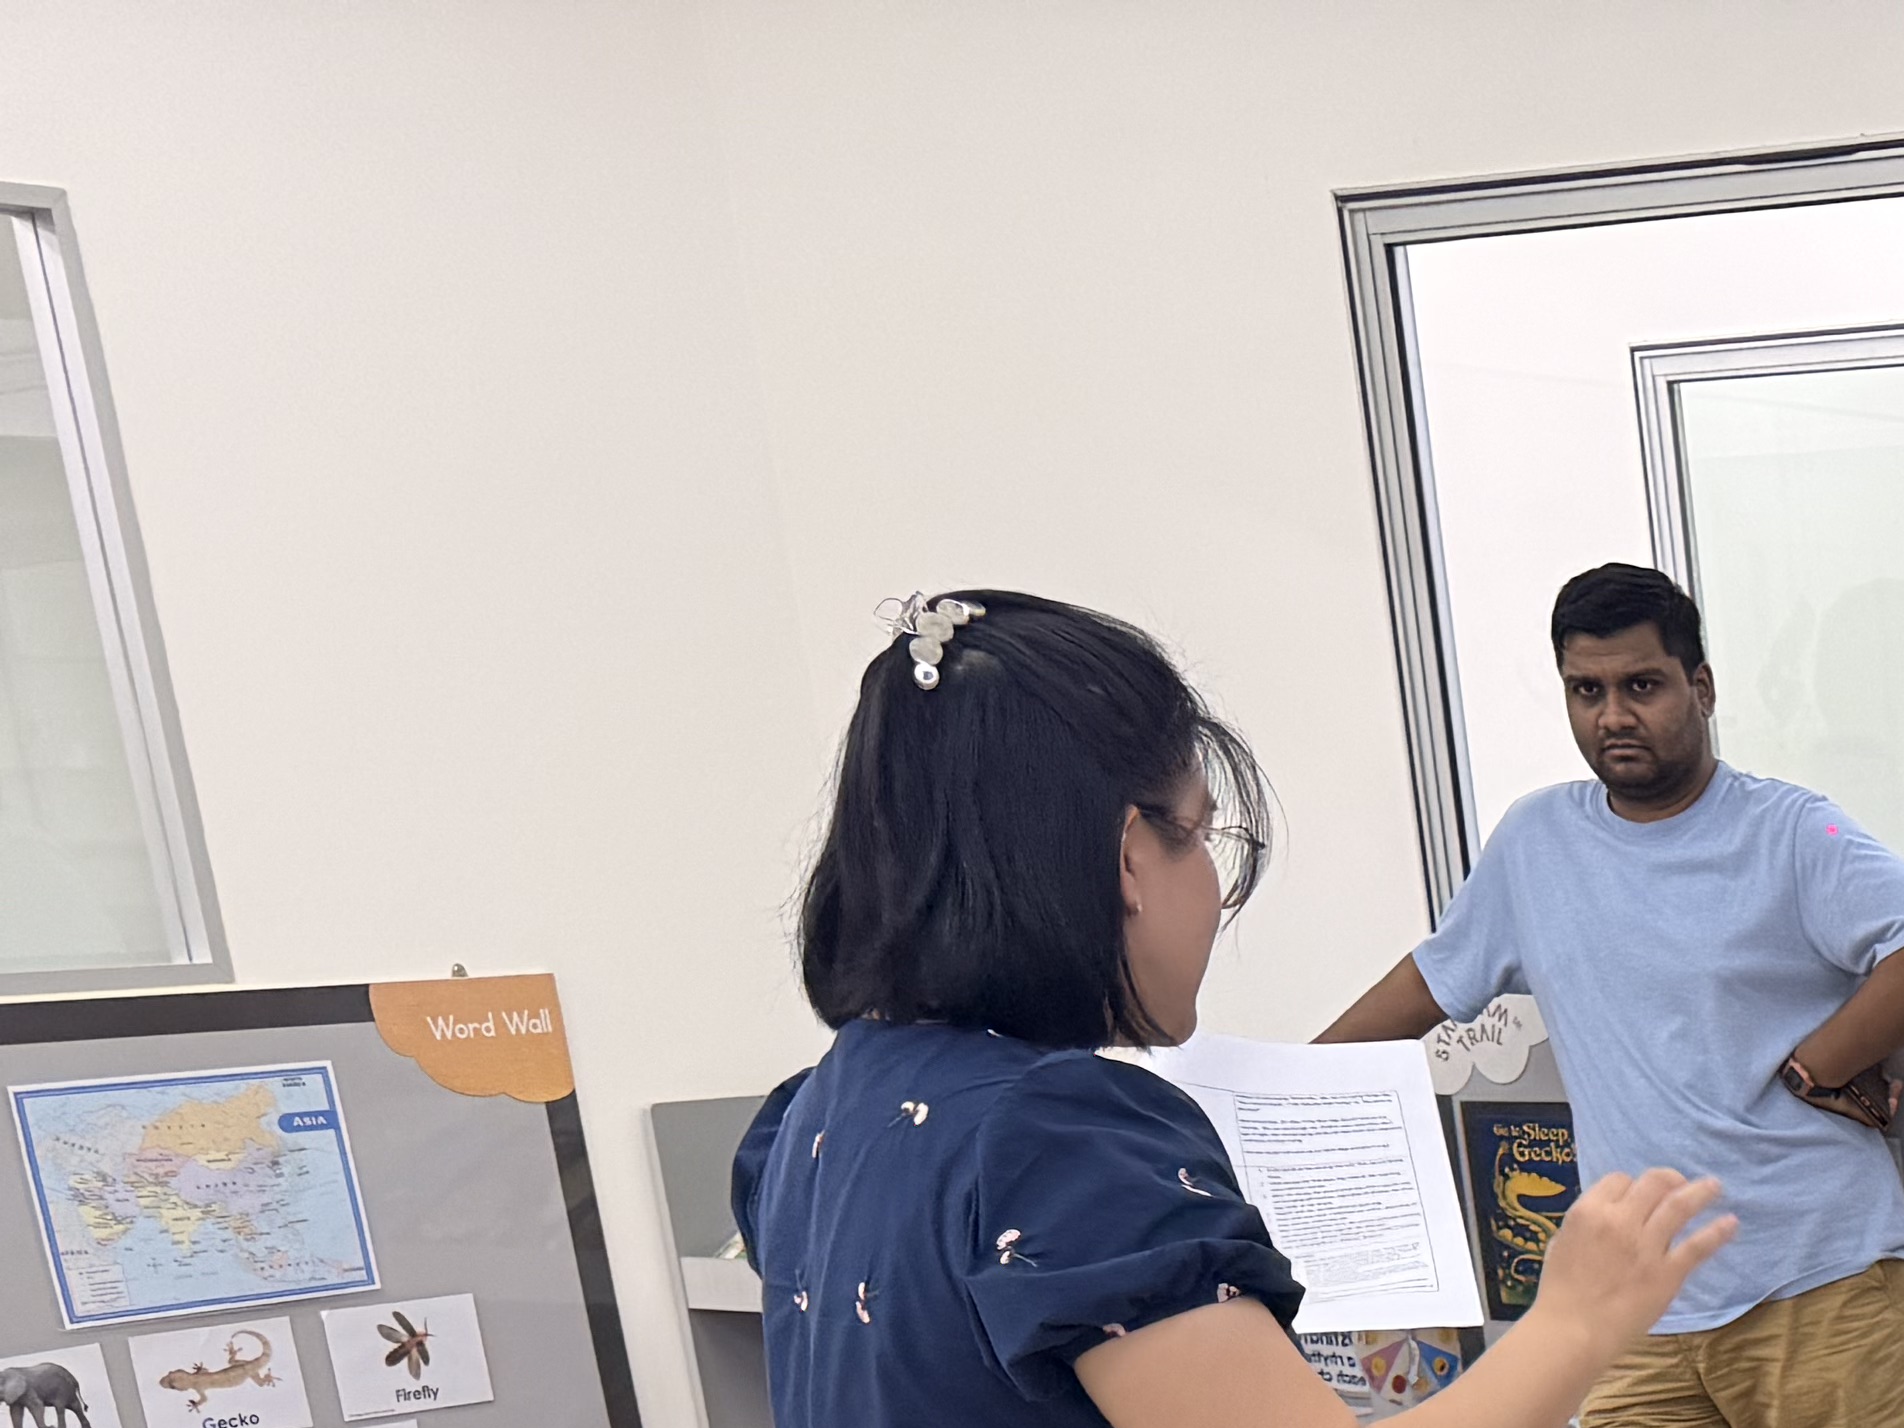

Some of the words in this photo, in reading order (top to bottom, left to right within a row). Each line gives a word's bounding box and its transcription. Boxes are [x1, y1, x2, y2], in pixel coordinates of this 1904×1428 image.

[427, 1010, 497, 1041] Word
[502, 1007, 553, 1036] Wall
[1456, 1023, 1504, 1053] TRAIL
[395, 1384, 440, 1403] Firefly
